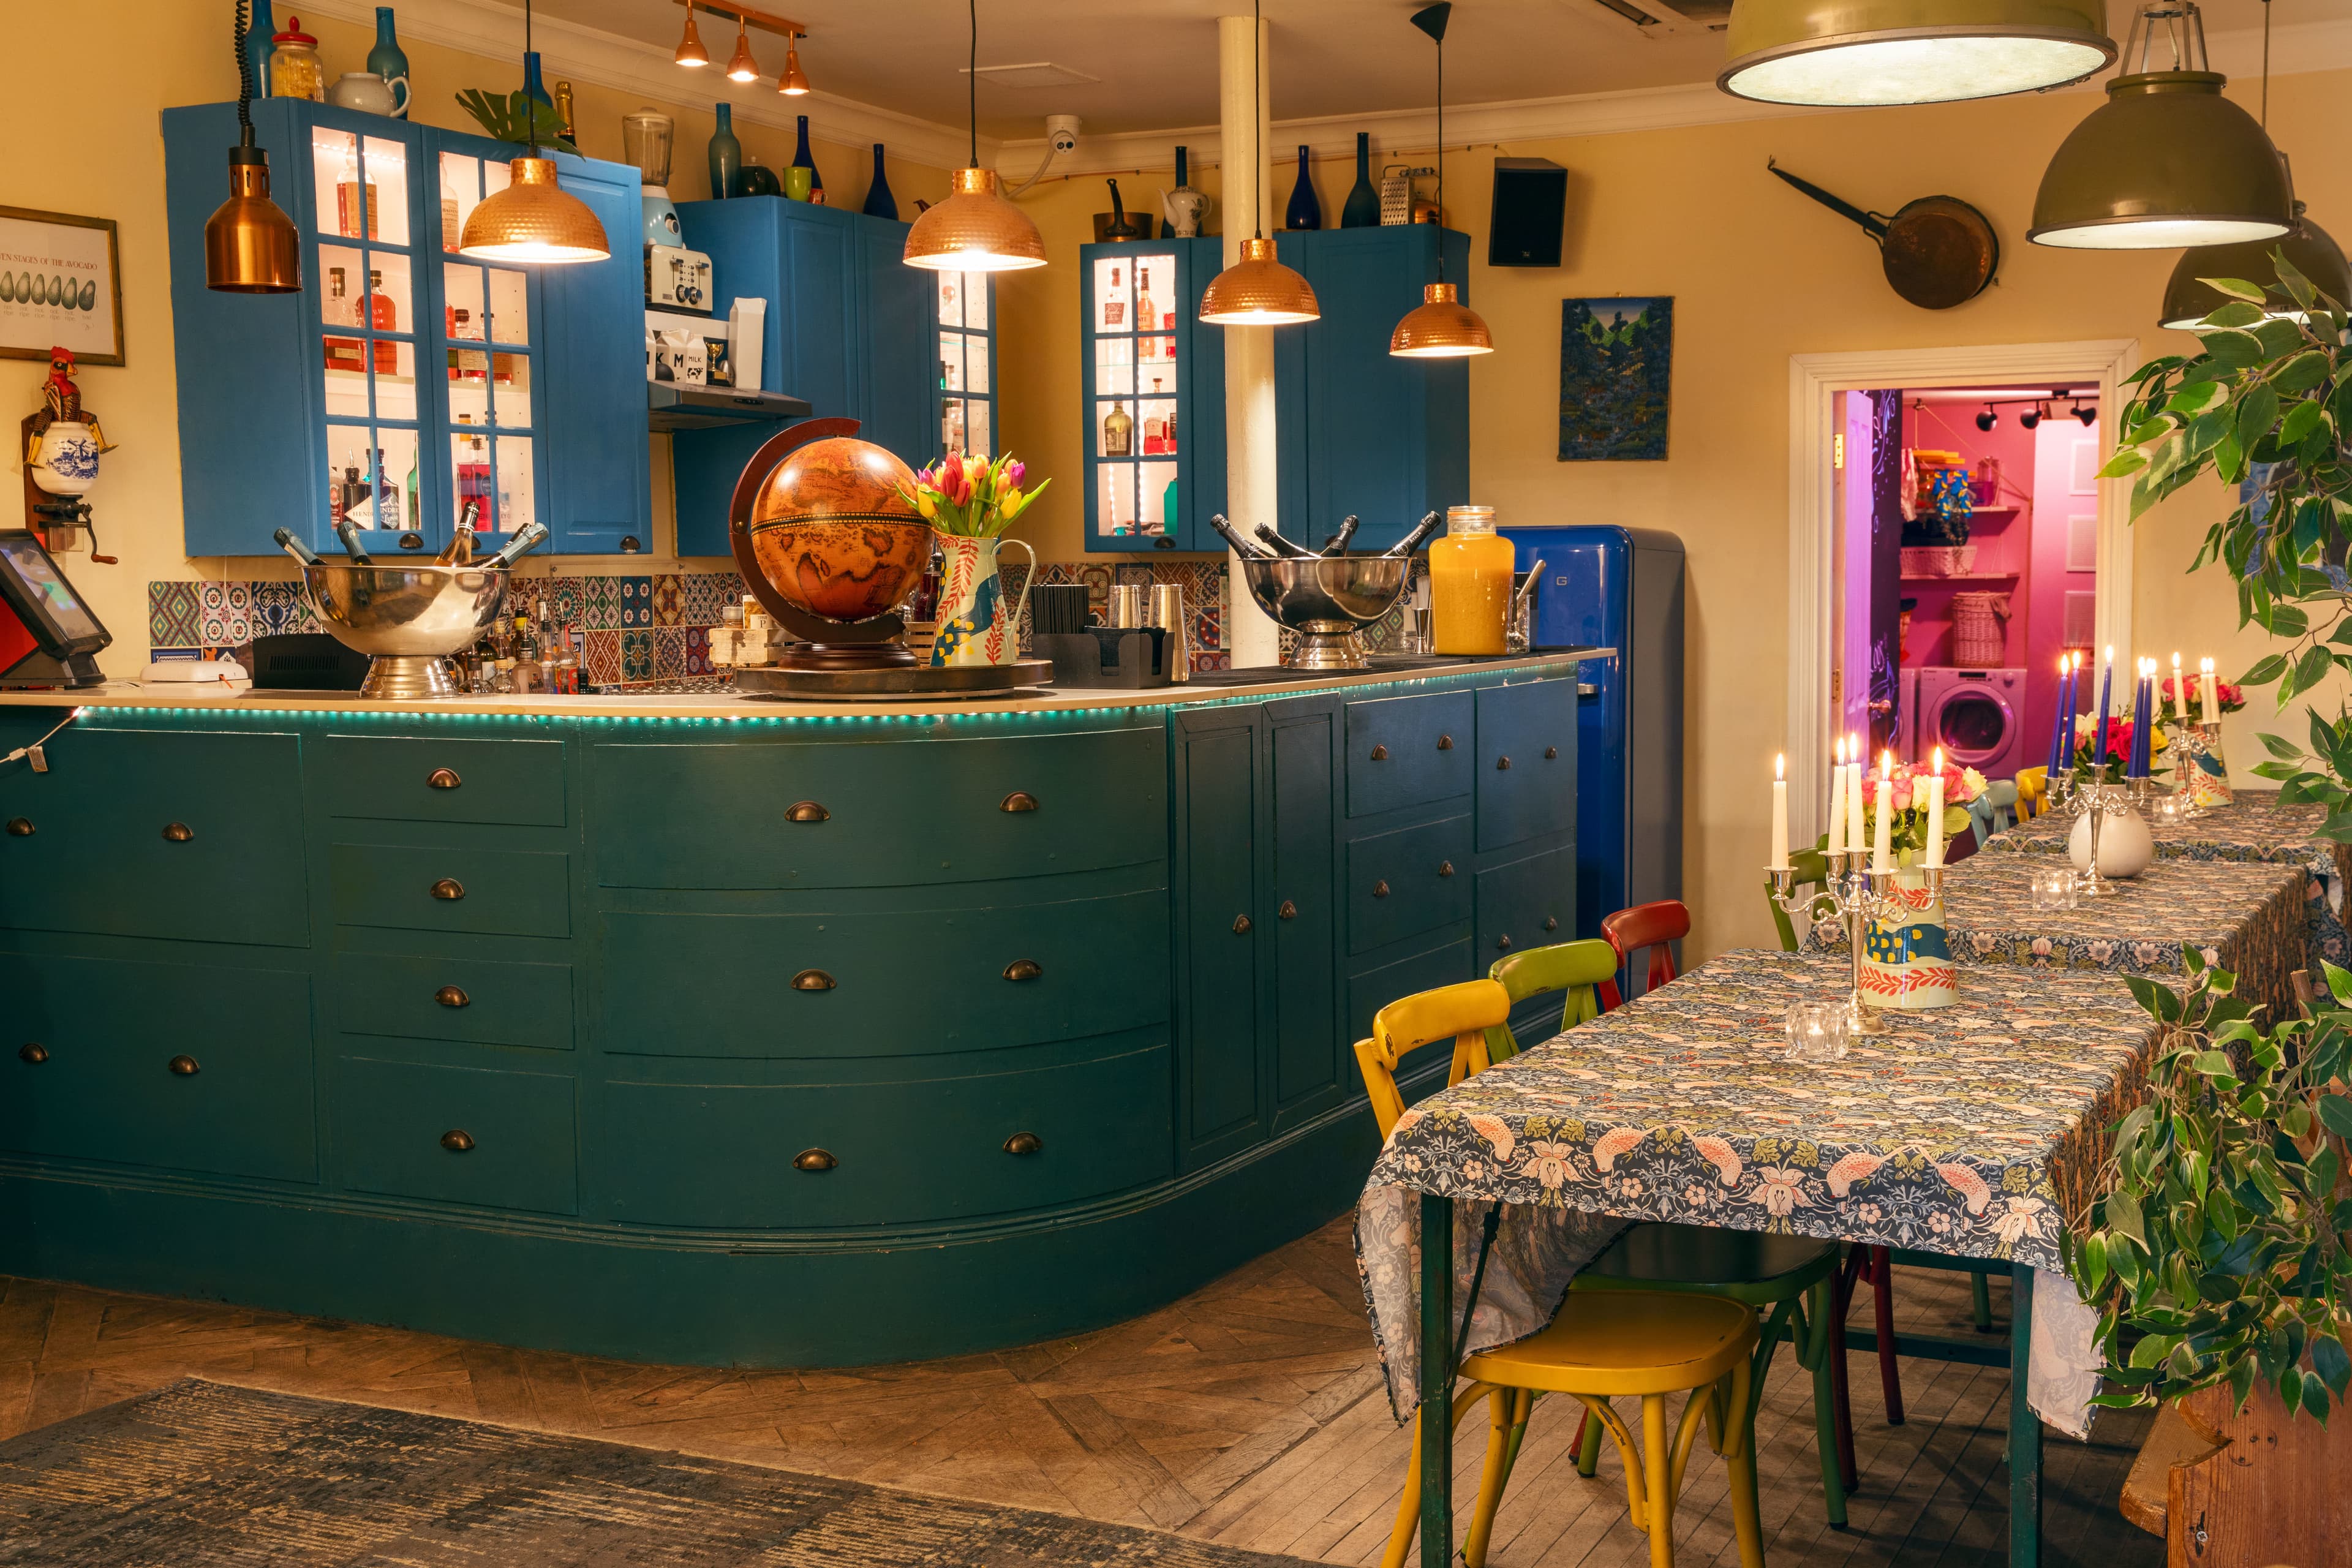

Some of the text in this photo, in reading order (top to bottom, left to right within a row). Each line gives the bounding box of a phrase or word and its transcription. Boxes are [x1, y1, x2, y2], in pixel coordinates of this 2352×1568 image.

[13, 254, 38, 265] STAGES
[51, 258, 64, 267] THE
[66, 261, 97, 270] AVOCADO
